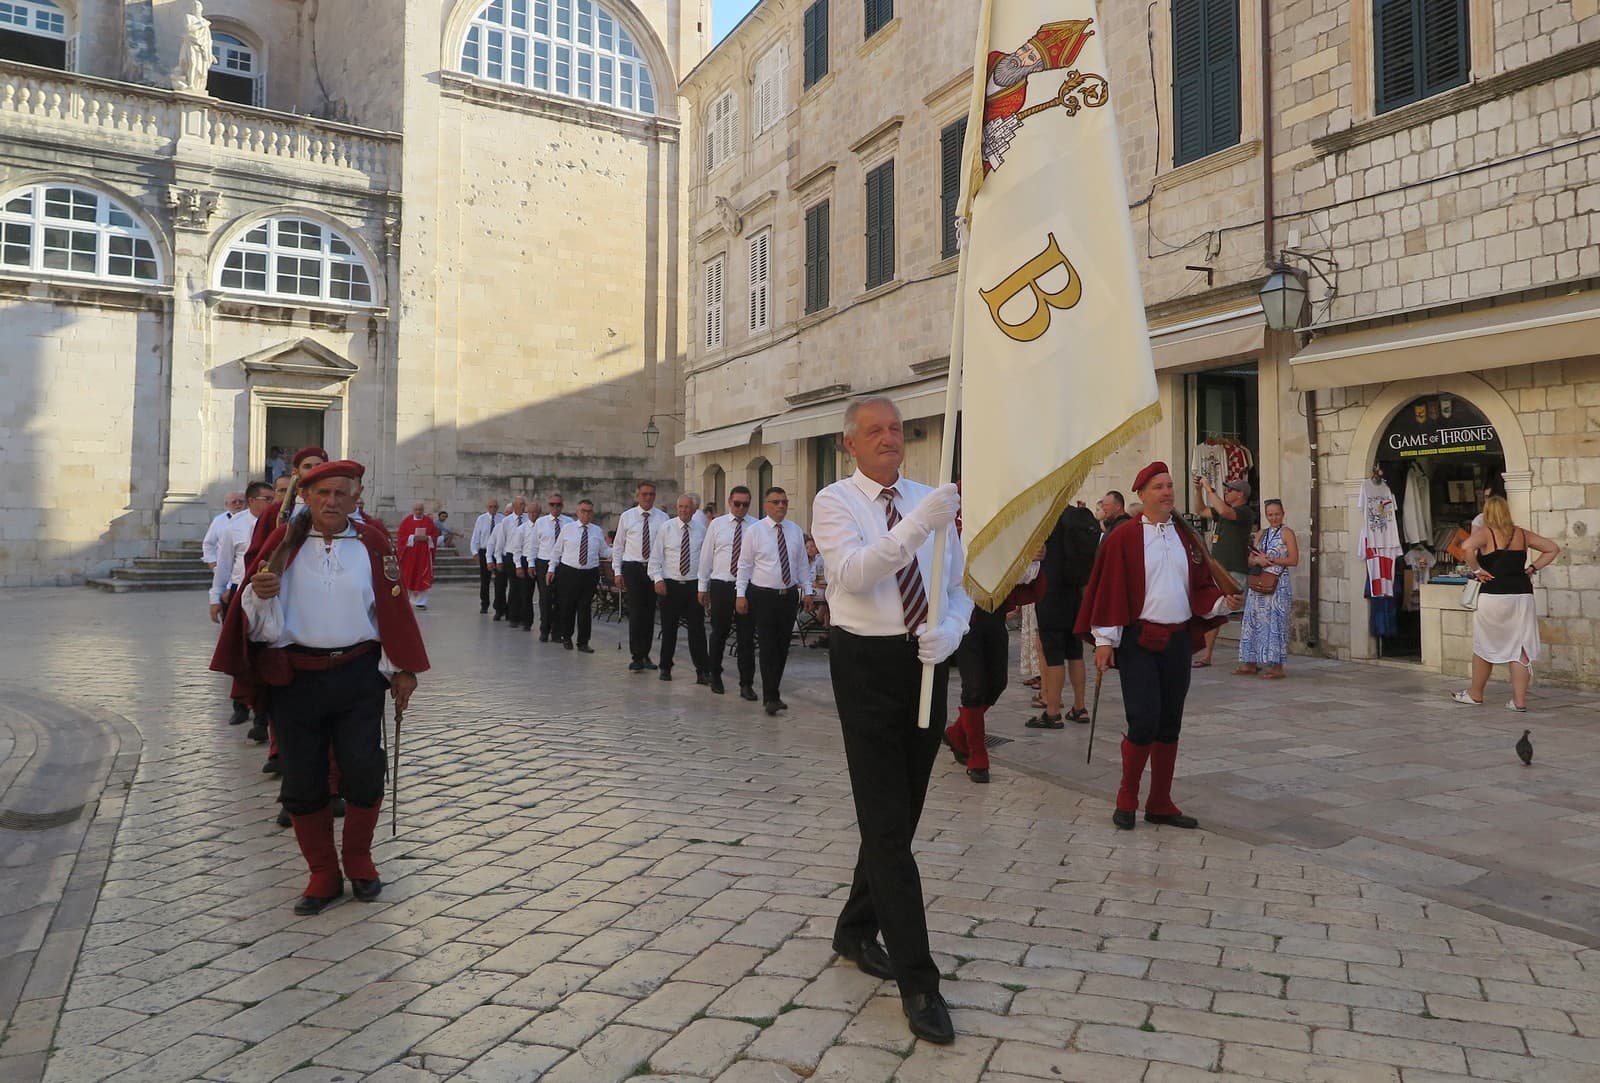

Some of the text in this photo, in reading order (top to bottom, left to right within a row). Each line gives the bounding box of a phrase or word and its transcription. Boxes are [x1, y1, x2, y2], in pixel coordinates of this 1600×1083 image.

[978, 231, 1082, 342] B
[1389, 424, 1494, 450] GAME OF THRONES
